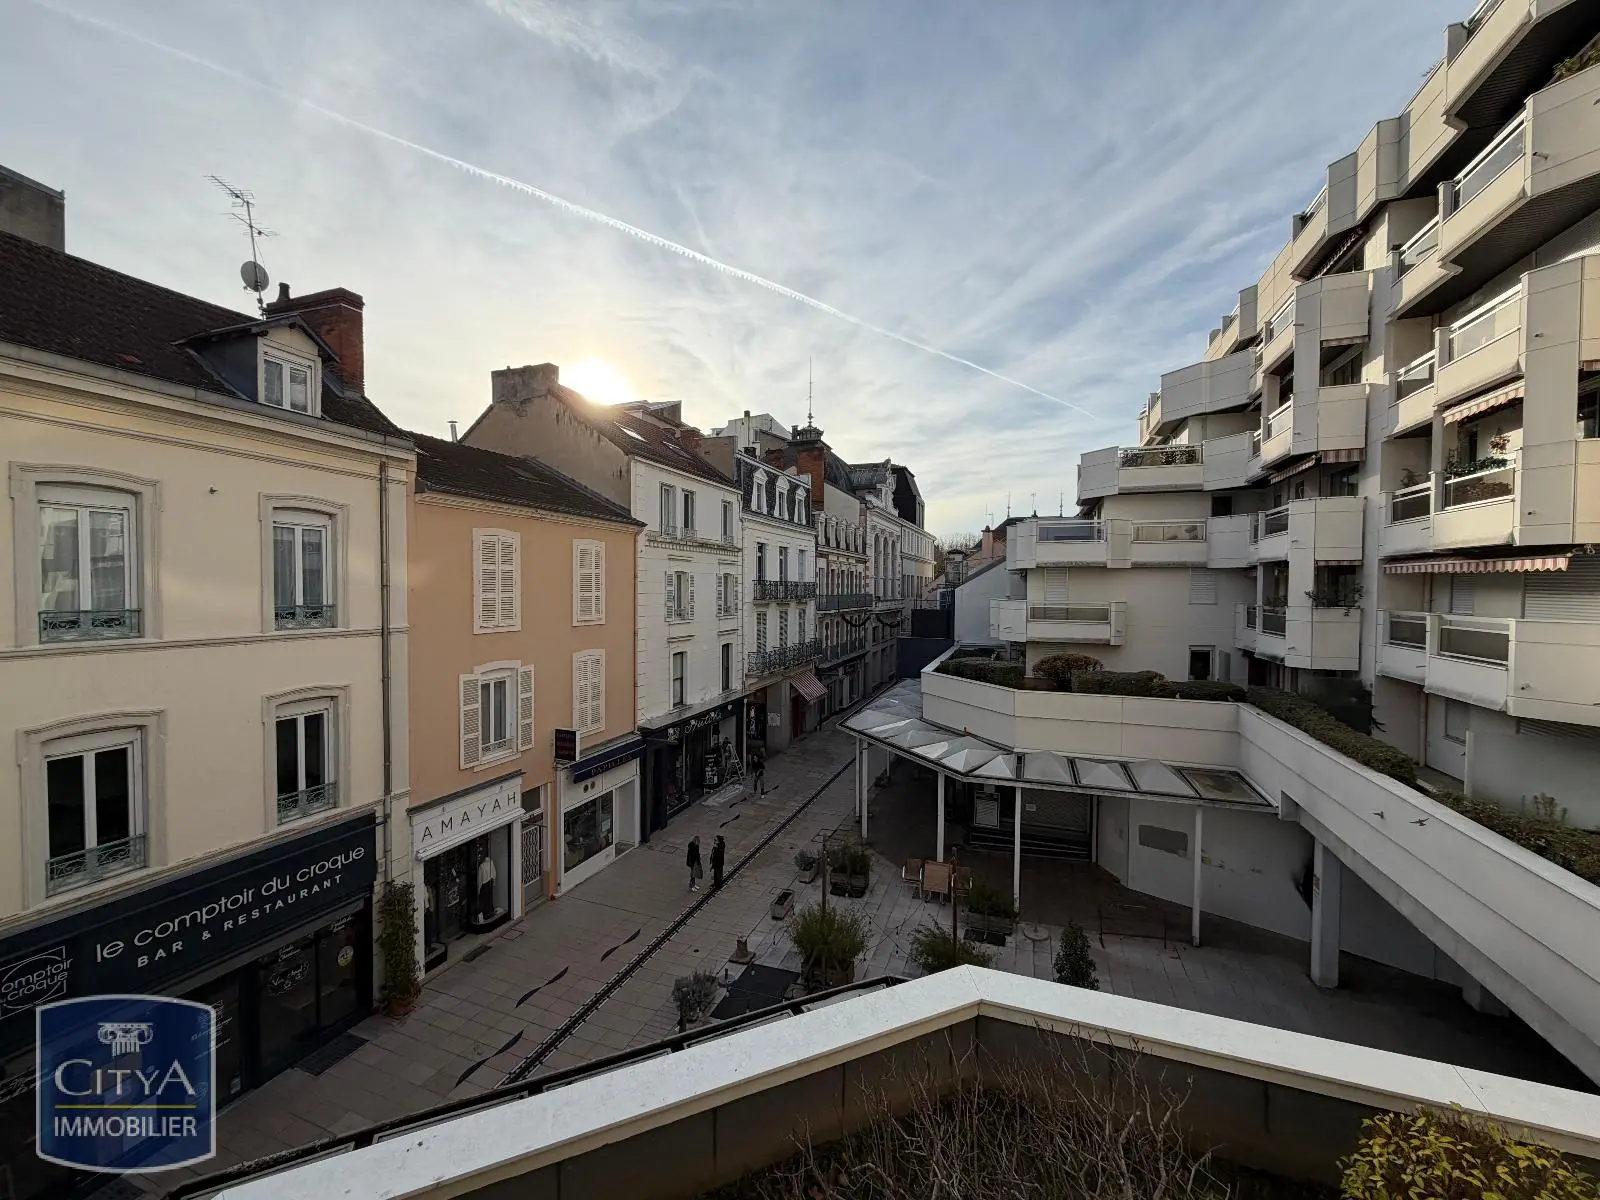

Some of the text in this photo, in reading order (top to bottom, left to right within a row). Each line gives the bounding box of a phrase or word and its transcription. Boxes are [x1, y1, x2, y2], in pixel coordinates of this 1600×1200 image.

[421, 792, 516, 842] AMAYAH
[96, 846, 366, 963] le comptoir du croque
[137, 940, 184, 968] BAR
[201, 928, 212, 940] &
[223, 874, 343, 932] RESTAURANT
[1, 957, 74, 993] omptoir
